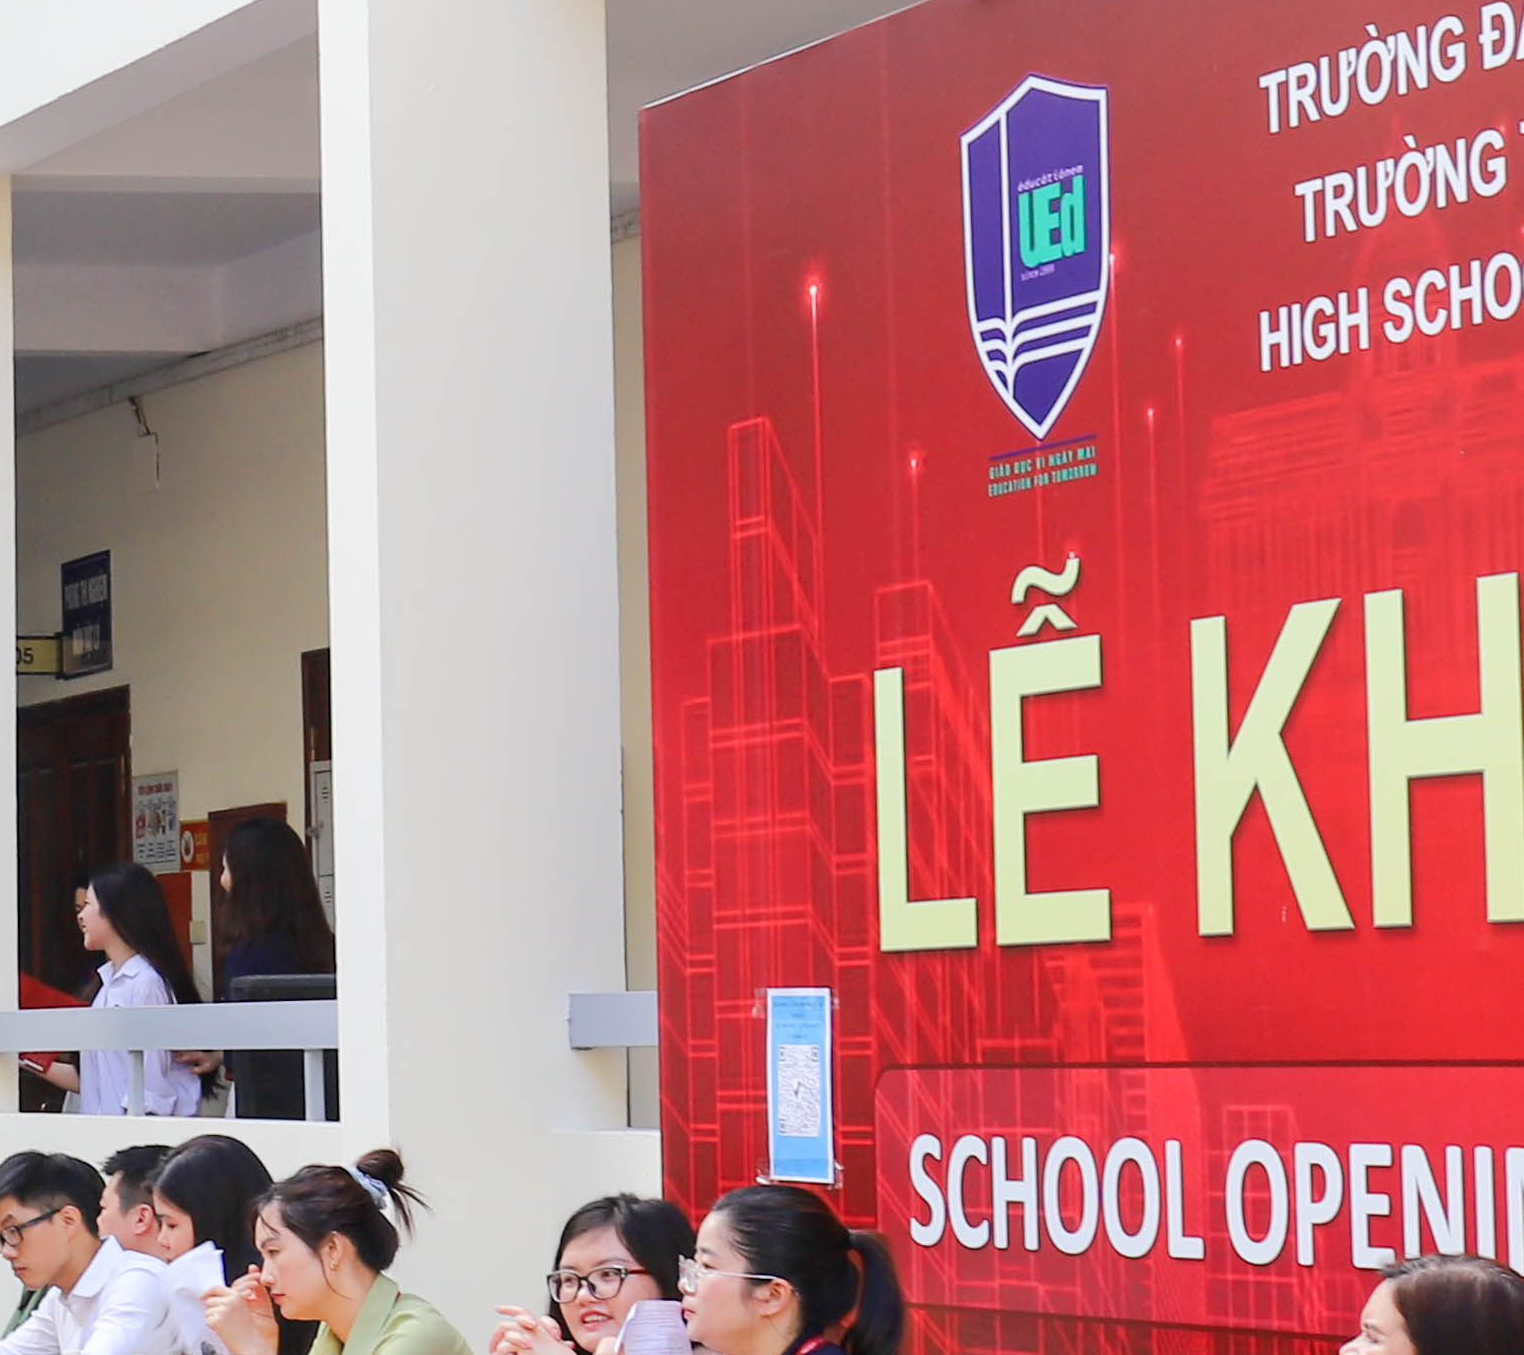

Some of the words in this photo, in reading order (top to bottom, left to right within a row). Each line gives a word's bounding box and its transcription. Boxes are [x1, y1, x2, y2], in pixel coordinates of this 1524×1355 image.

[1258, 15, 1466, 134] TRƯỜNG
[1018, 174, 1086, 268] UEd
[1293, 128, 1508, 243] TRƯỜNG
[1259, 287, 1370, 373] HIGH
[1382, 251, 1524, 344] SCHO
[873, 553, 1113, 952] LỄ
[908, 1133, 1205, 1260] SCHOOL
